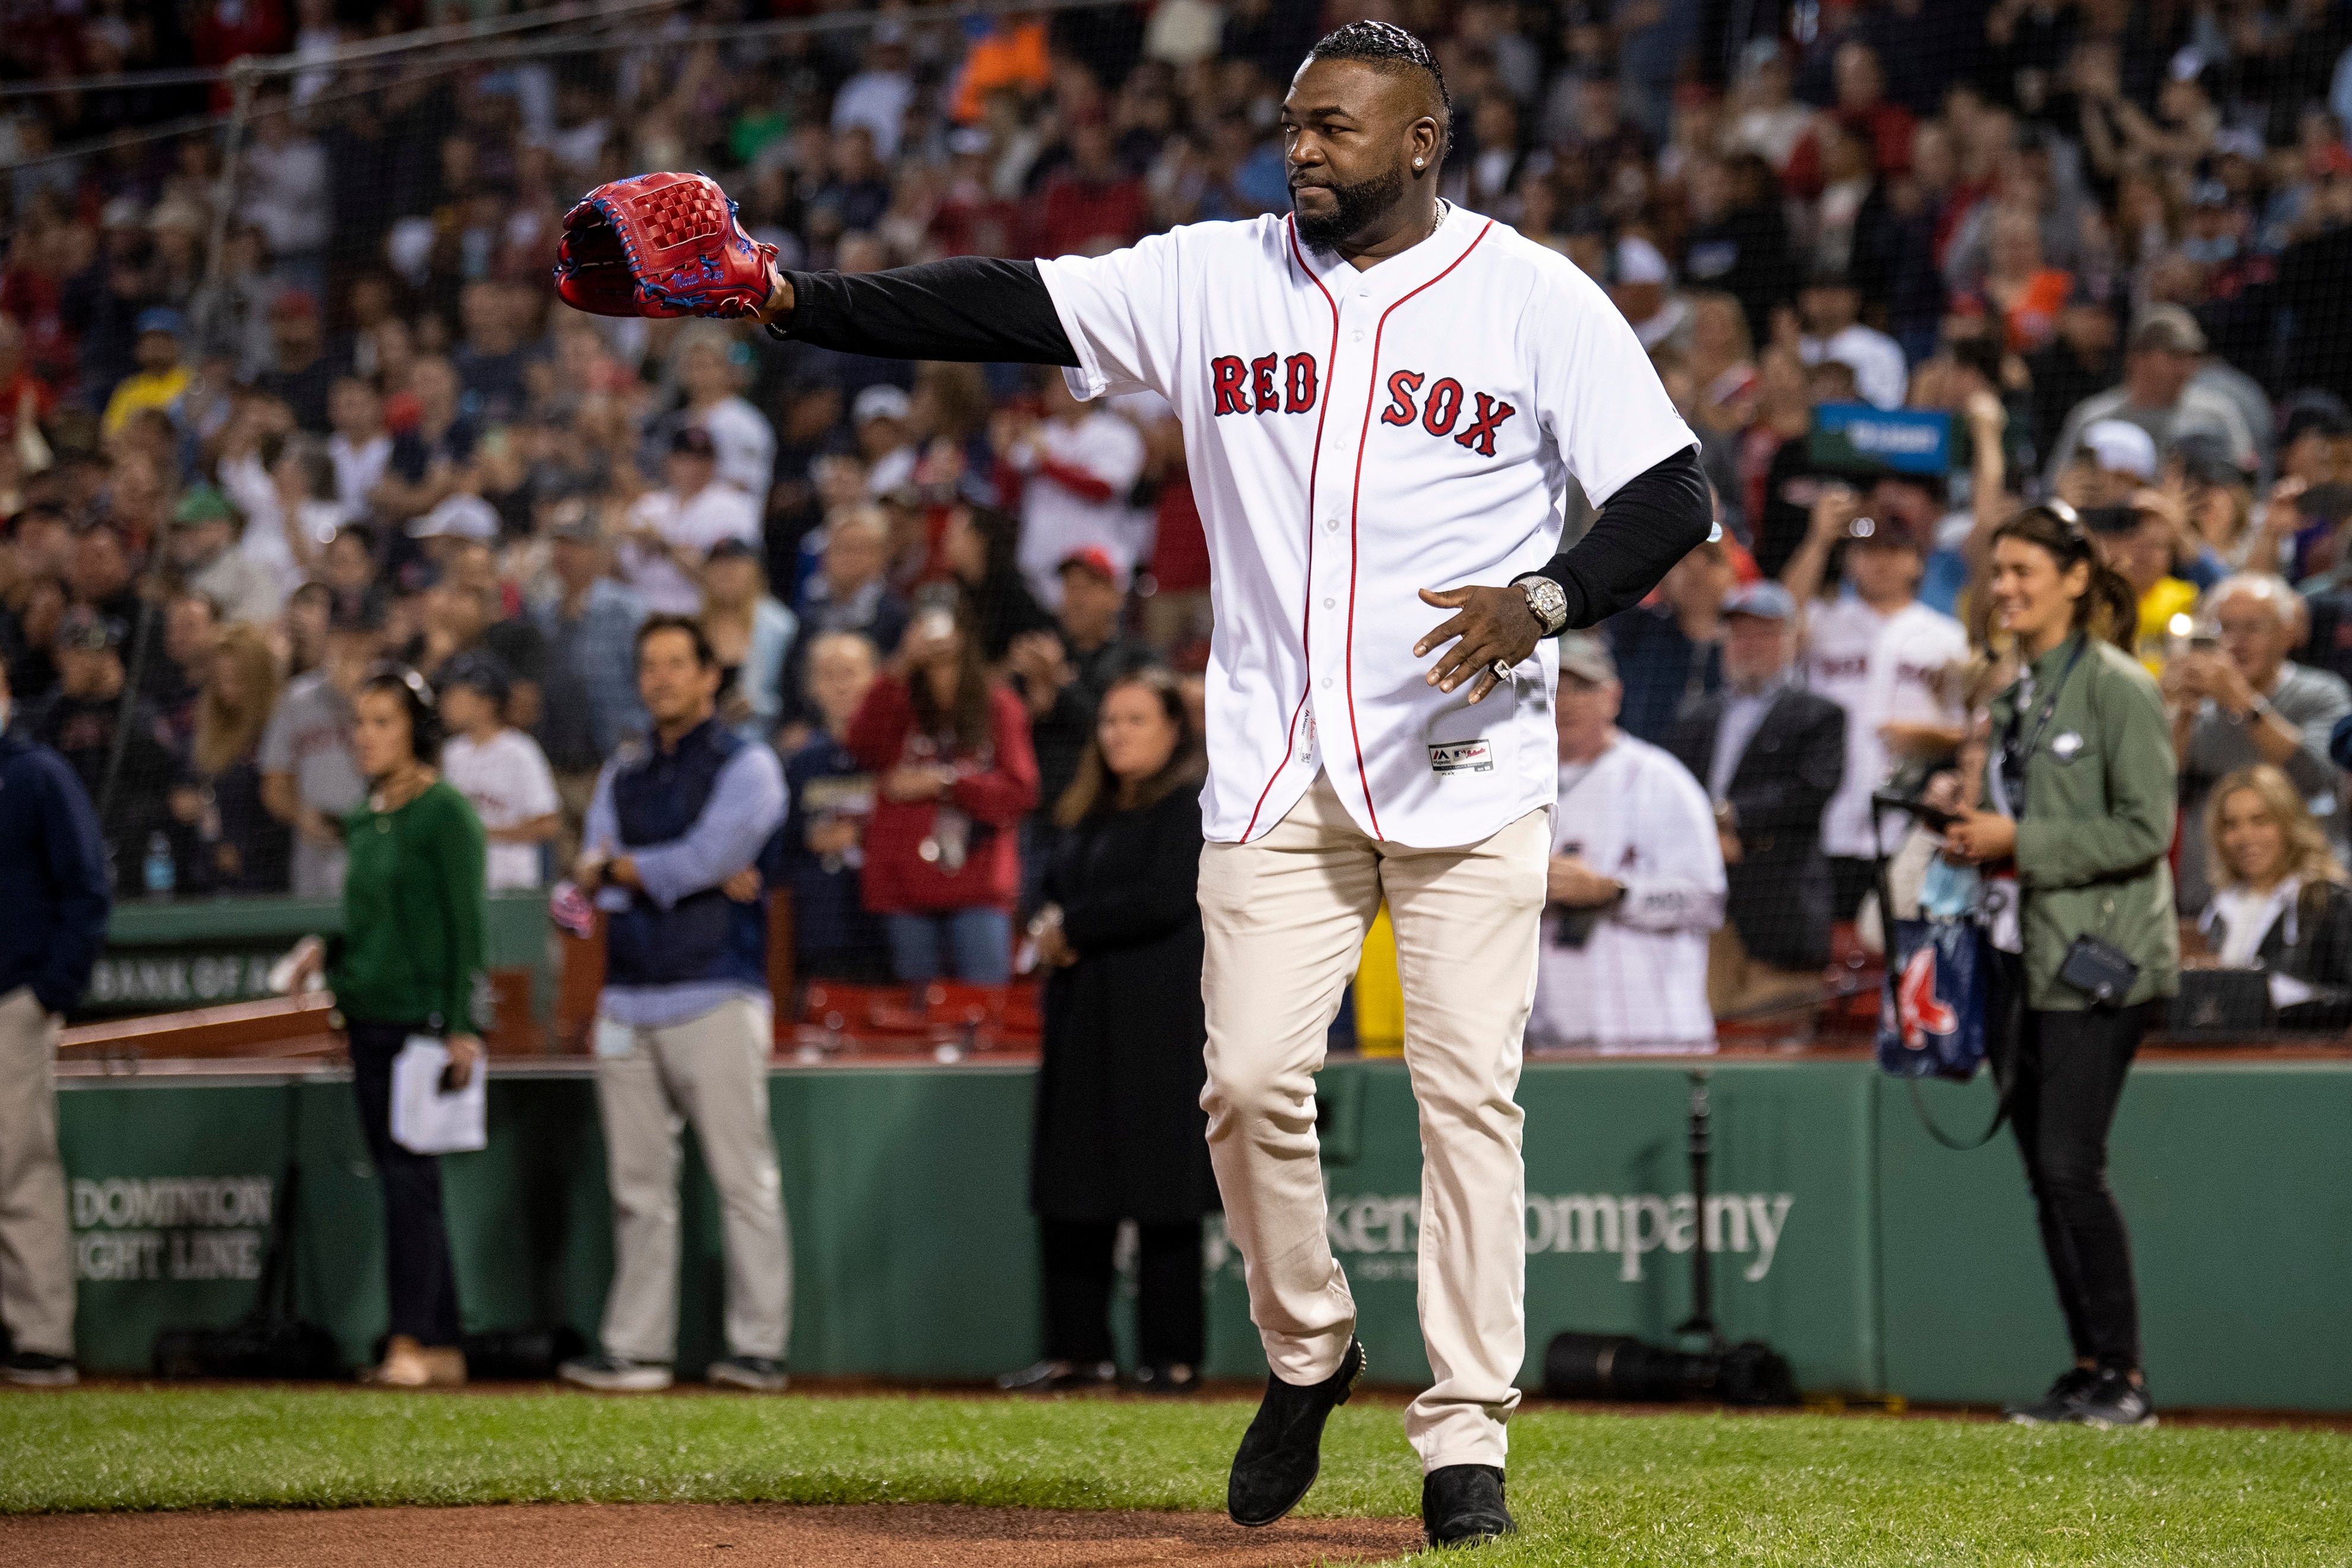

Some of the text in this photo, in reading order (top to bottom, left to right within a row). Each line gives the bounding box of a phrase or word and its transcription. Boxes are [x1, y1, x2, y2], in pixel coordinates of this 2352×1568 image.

[1211, 352, 1516, 457] RED SOX
[72, 1177, 271, 1225] DOMINION
[1525, 1193, 1794, 1282] ompany
